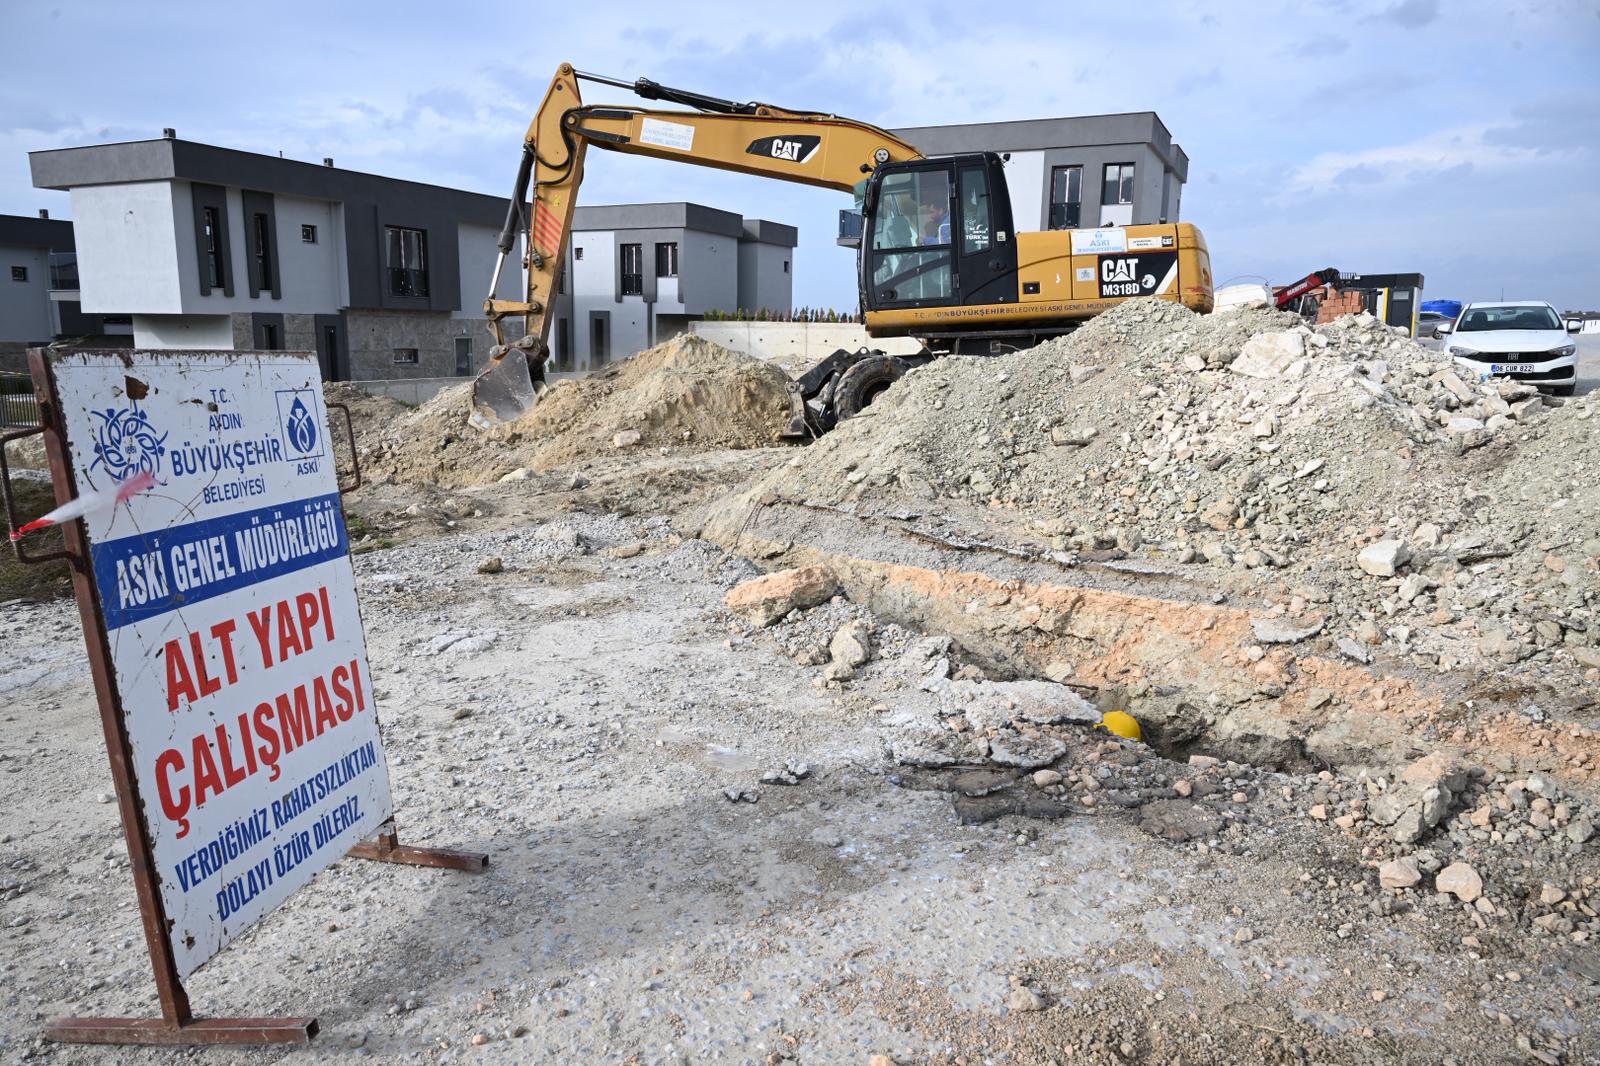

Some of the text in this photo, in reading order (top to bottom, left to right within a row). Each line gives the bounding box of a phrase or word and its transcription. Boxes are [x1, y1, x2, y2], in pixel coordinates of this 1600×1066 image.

[771, 138, 802, 161] CAT
[1102, 258, 1139, 282] CAT
[1102, 283, 1140, 296] M318D
[1507, 352, 1520, 360] FIAT
[209, 389, 231, 404] T.C.
[209, 413, 242, 431] AYDIN
[170, 433, 283, 477] BÜYÜKŞEHİR
[297, 459, 318, 476] ASKİ
[203, 474, 266, 504] BELEDİYESİ
[116, 500, 339, 610] ASKİ GENEL MÜDÜRLÜĞÜ
[164, 586, 335, 712] ALT YAPI
[155, 659, 365, 839] ÇALIŞMASI
[174, 740, 376, 893] VERDİĞİMİZ RAHATSIZLIKTAN
[216, 795, 365, 922] DOLAYI ÖZÜR DİLERİZ.
